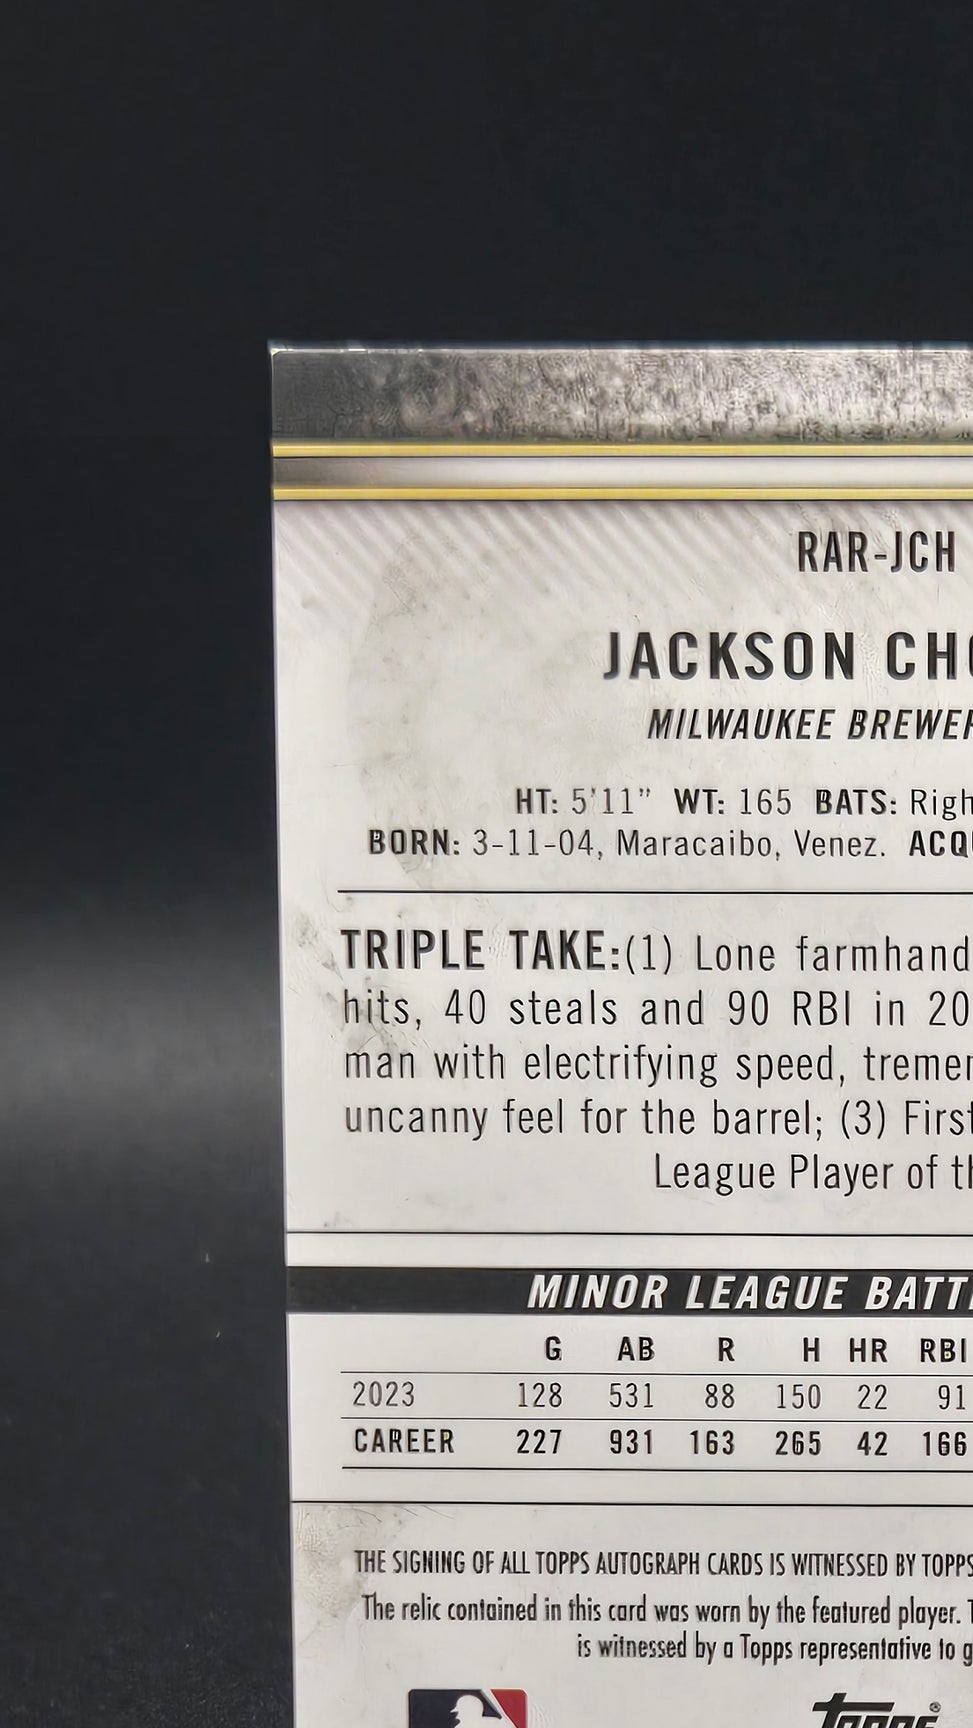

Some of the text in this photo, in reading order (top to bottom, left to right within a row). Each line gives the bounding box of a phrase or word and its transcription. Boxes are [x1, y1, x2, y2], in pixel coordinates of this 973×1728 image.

[799, 531, 954, 572] RAR-JCH
[604, 632, 853, 680] JACKSON
[648, 709, 835, 739] MILWAUKEE
[517, 789, 557, 814] HT:
[674, 788, 724, 814] WT:
[741, 788, 791, 815] 165
[816, 789, 896, 815] BATS:
[370, 829, 459, 855] BORN:
[474, 829, 602, 860] 3-11-04,
[618, 829, 780, 857] Maracaibo,
[794, 829, 884, 857] Venez.
[341, 929, 484, 969] TRIPLE
[697, 935, 775, 971] Lone
[796, 935, 969, 972] farmhand
[346, 1052, 414, 1078] man
[434, 1043, 504, 1079] with
[525, 1044, 717, 1088] electrifying
[737, 1044, 844, 1088] speed,
[528, 1274, 668, 1311] MINOR
[686, 1275, 848, 1311] LEAGUE
[546, 1336, 561, 1360] G
[618, 1337, 654, 1361] AB
[719, 1337, 734, 1361] R
[804, 1337, 819, 1362] H
[850, 1338, 887, 1362] HR
[921, 1338, 966, 1362] RBI
[355, 1428, 454, 1452] CAREER
[517, 1429, 562, 1454] 227
[610, 1430, 651, 1454] 931
[690, 1430, 734, 1455] 163
[776, 1431, 820, 1455] 265
[857, 1431, 887, 1455] 42
[923, 1432, 966, 1457] 166
[354, 1550, 385, 1572] THE
[393, 1550, 465, 1573] SIGNING
[473, 1551, 494, 1574] OF
[501, 1551, 530, 1575] ALL
[536, 1551, 589, 1574] TOPPS
[596, 1552, 699, 1575] AUTOGRAPH
[708, 1553, 763, 1575] CARDS
[770, 1553, 785, 1576] IS
[792, 1552, 887, 1576] WITNESSED
[897, 1553, 916, 1576] BY
[362, 1592, 394, 1620] The
[403, 1593, 441, 1620] relic
[448, 1593, 536, 1621] contained
[545, 1597, 561, 1620] in
[569, 1593, 601, 1621] this
[609, 1594, 646, 1621] card
[654, 1605, 688, 1622] was
[696, 1605, 740, 1622] worn
[748, 1595, 770, 1629] by
[777, 1595, 805, 1623] the
[813, 1595, 890, 1623] featured
[899, 1596, 961, 1631] player.
